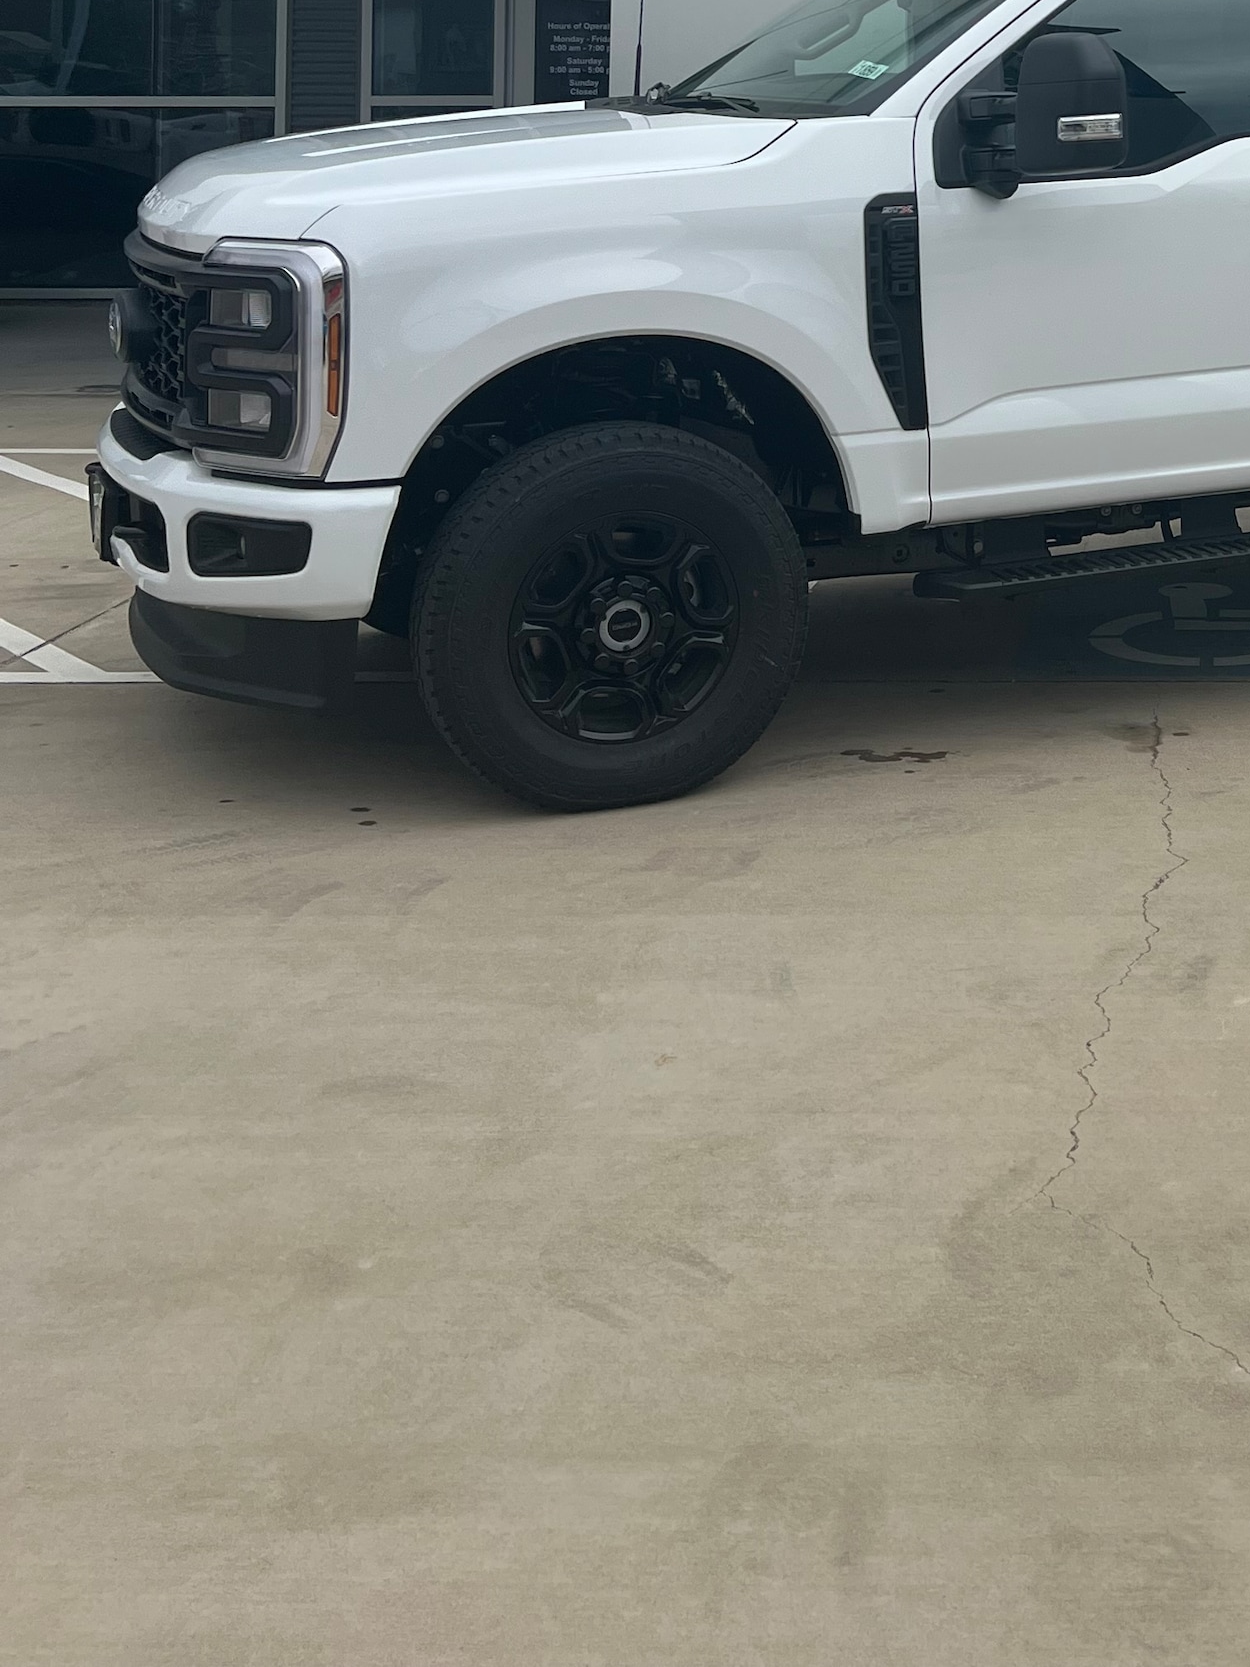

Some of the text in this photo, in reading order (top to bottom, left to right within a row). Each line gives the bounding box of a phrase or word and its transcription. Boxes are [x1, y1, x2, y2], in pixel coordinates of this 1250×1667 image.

[547, 22, 571, 30] Hours
[573, 22, 582, 30] of
[553, 35, 585, 44] Monday
[588, 44, 605, 52] 7:00
[567, 57, 602, 65] Saturday
[569, 79, 599, 88] Sunday
